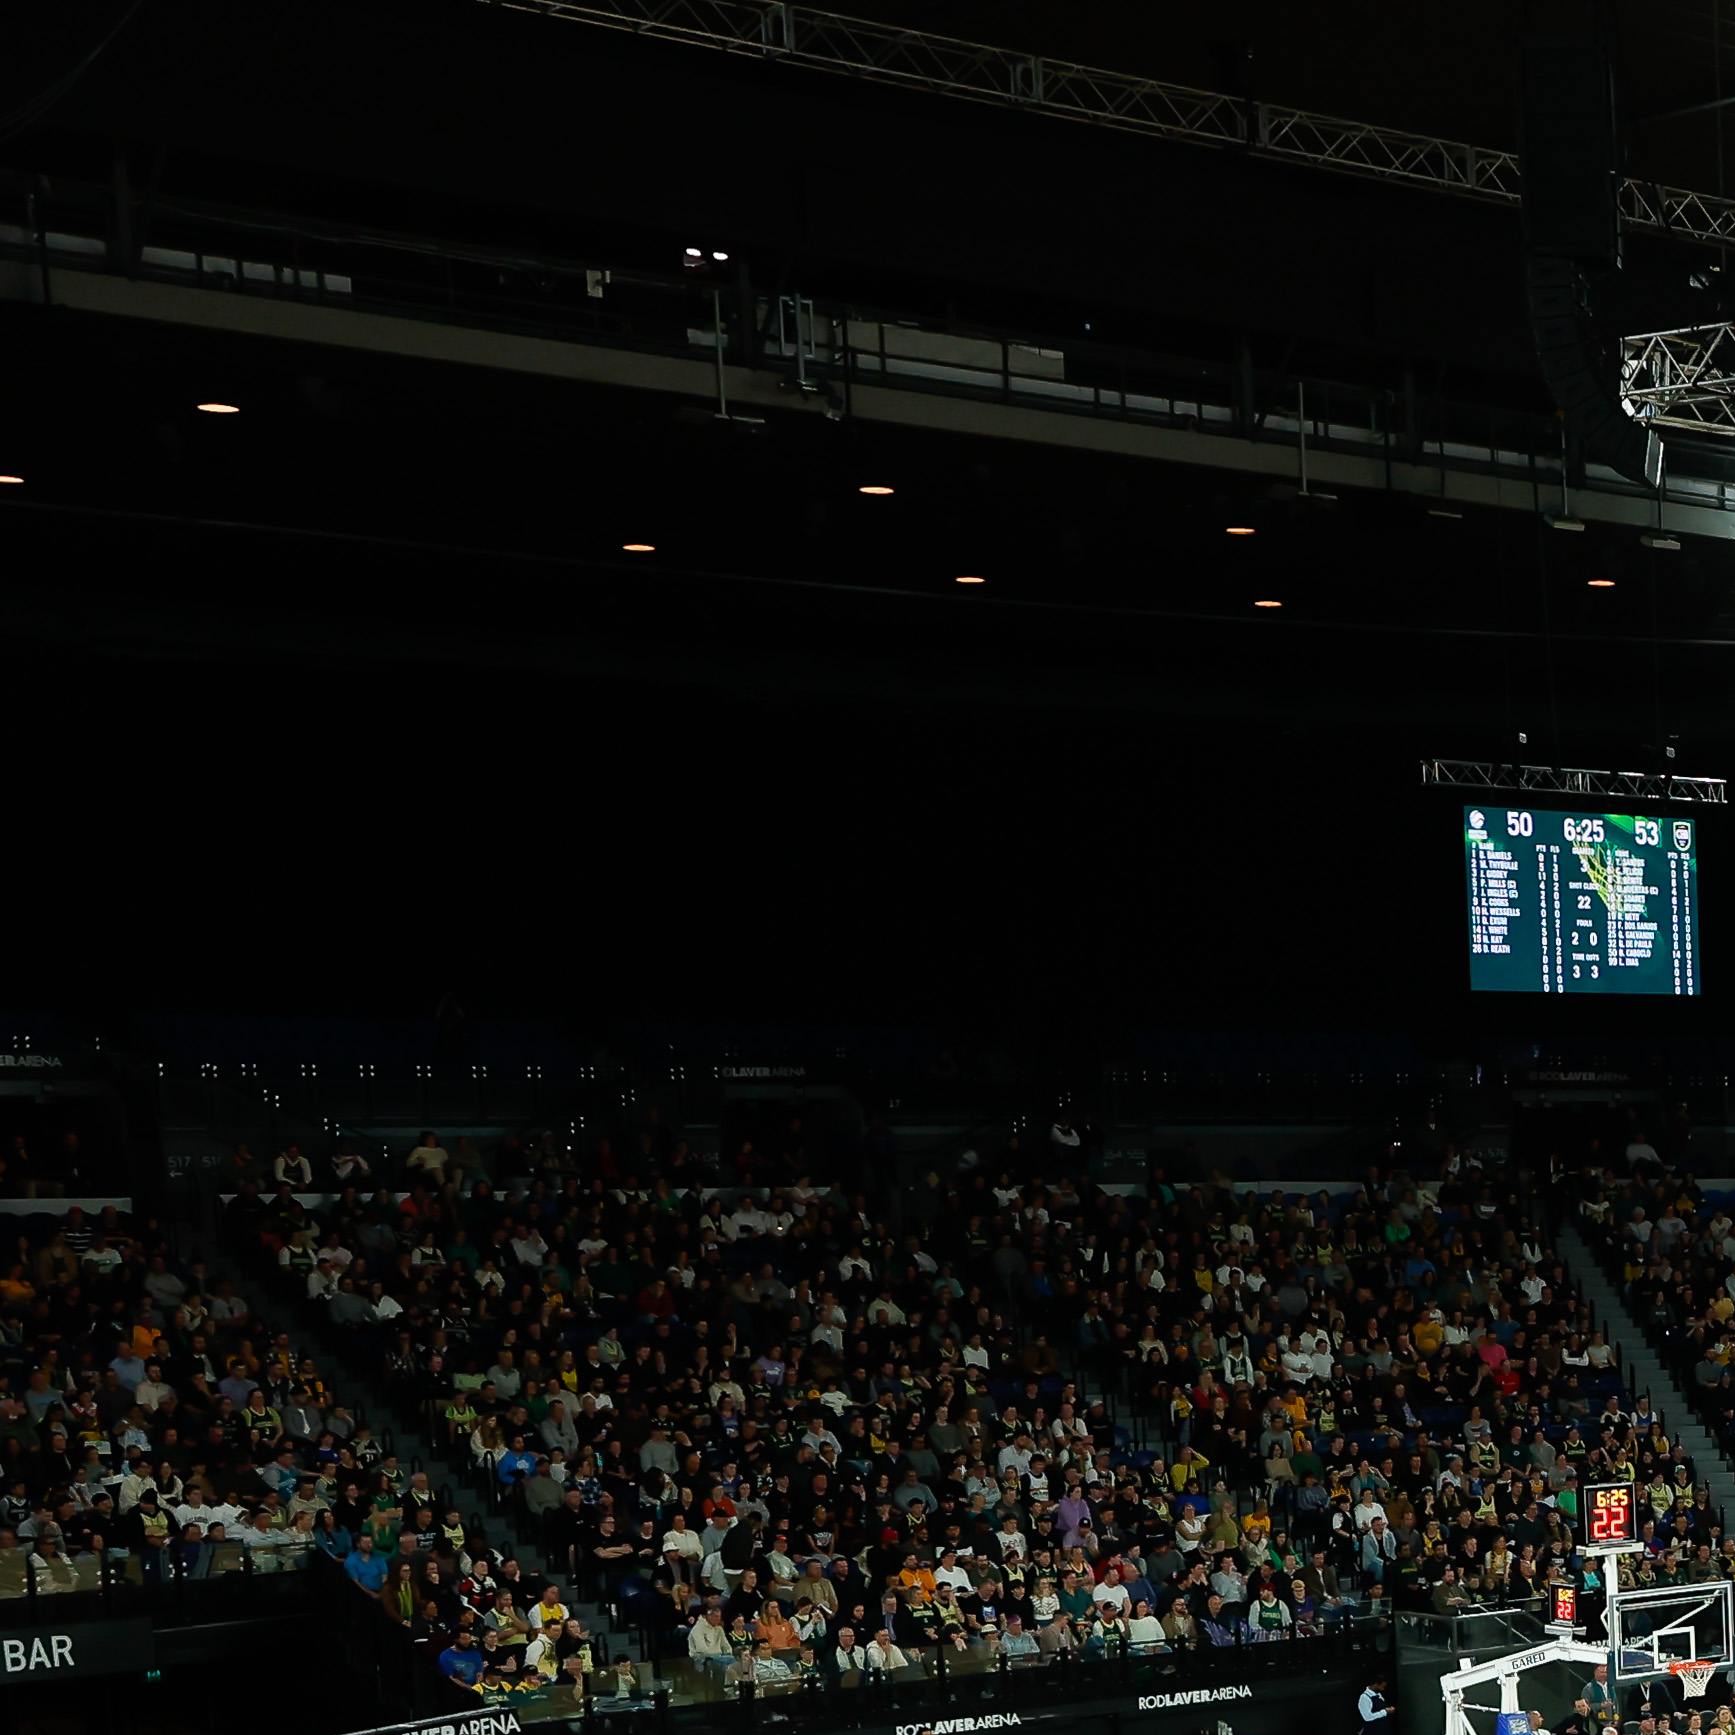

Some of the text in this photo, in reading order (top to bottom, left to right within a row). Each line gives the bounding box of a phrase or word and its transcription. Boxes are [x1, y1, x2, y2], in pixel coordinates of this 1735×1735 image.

[1507, 811, 1659, 846] 50 6:25 53
[1580, 860, 1589, 872] 3
[1577, 896, 1591, 909] 22
[1572, 932, 1597, 946] 2 0
[1573, 965, 1598, 978] 3 3
[1597, 1488, 1628, 1508] 6:25
[3, 1634, 75, 1673] BAR
[1511, 1652, 1547, 1671] GARED
